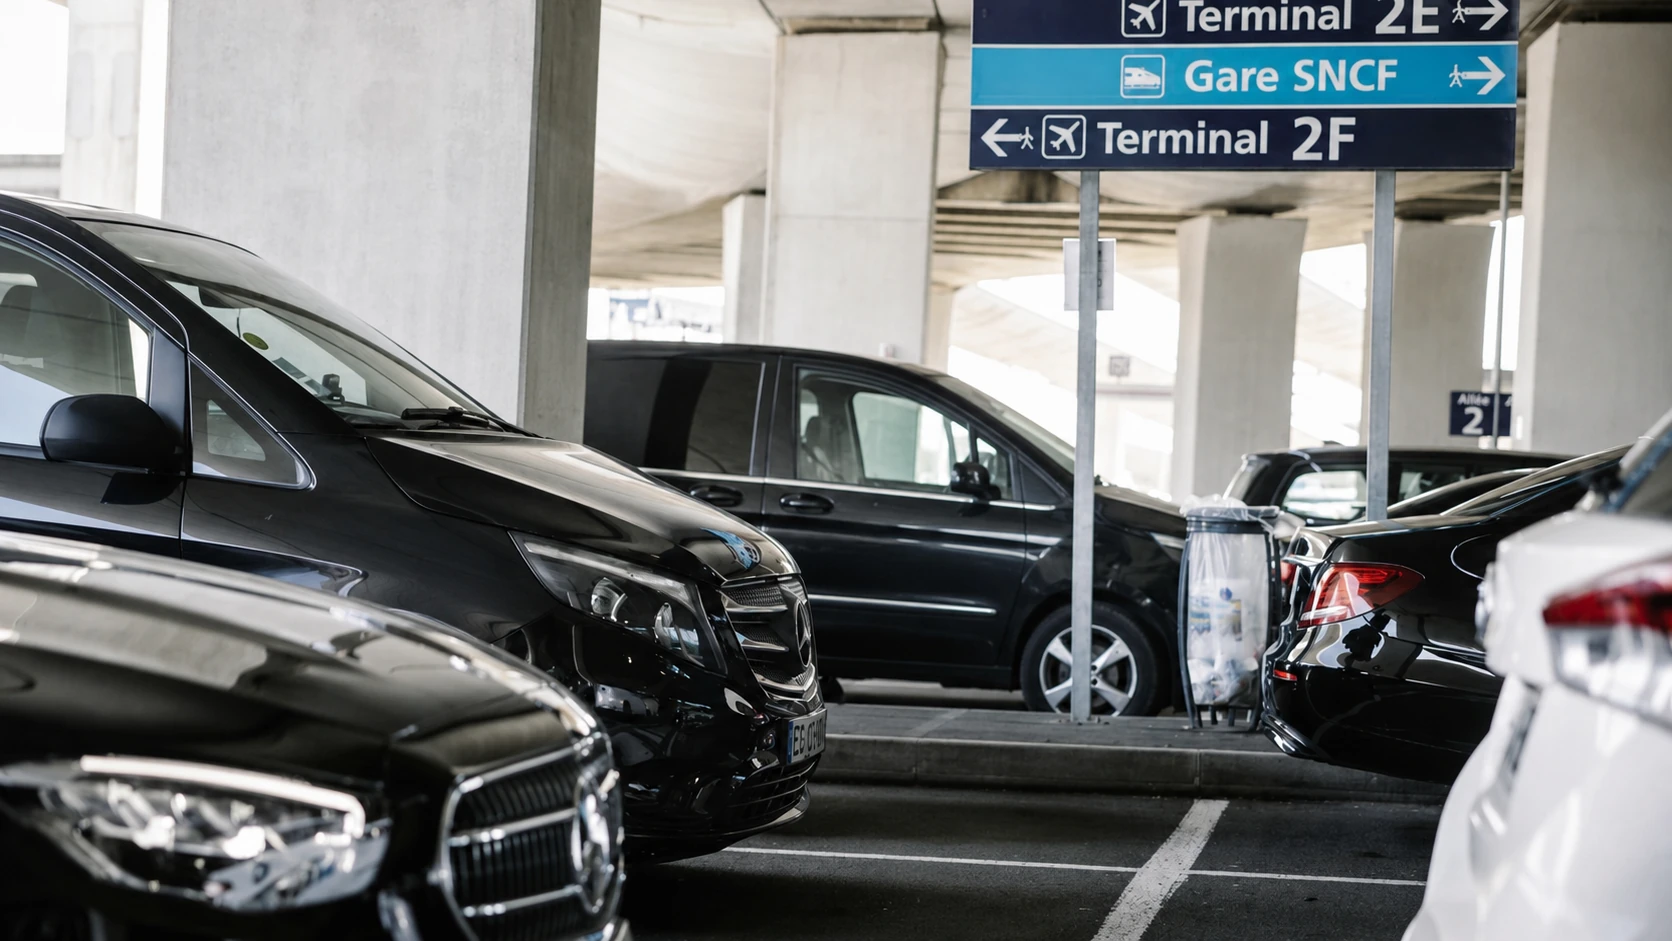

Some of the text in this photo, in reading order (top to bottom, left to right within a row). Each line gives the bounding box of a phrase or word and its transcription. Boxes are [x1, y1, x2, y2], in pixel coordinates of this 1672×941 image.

[1178, 0, 1440, 34] Terminal 2E
[1184, 58, 1398, 93] Gare SNCF
[1096, 116, 1356, 161] Terminal 2F
[1462, 406, 1484, 435] 2
